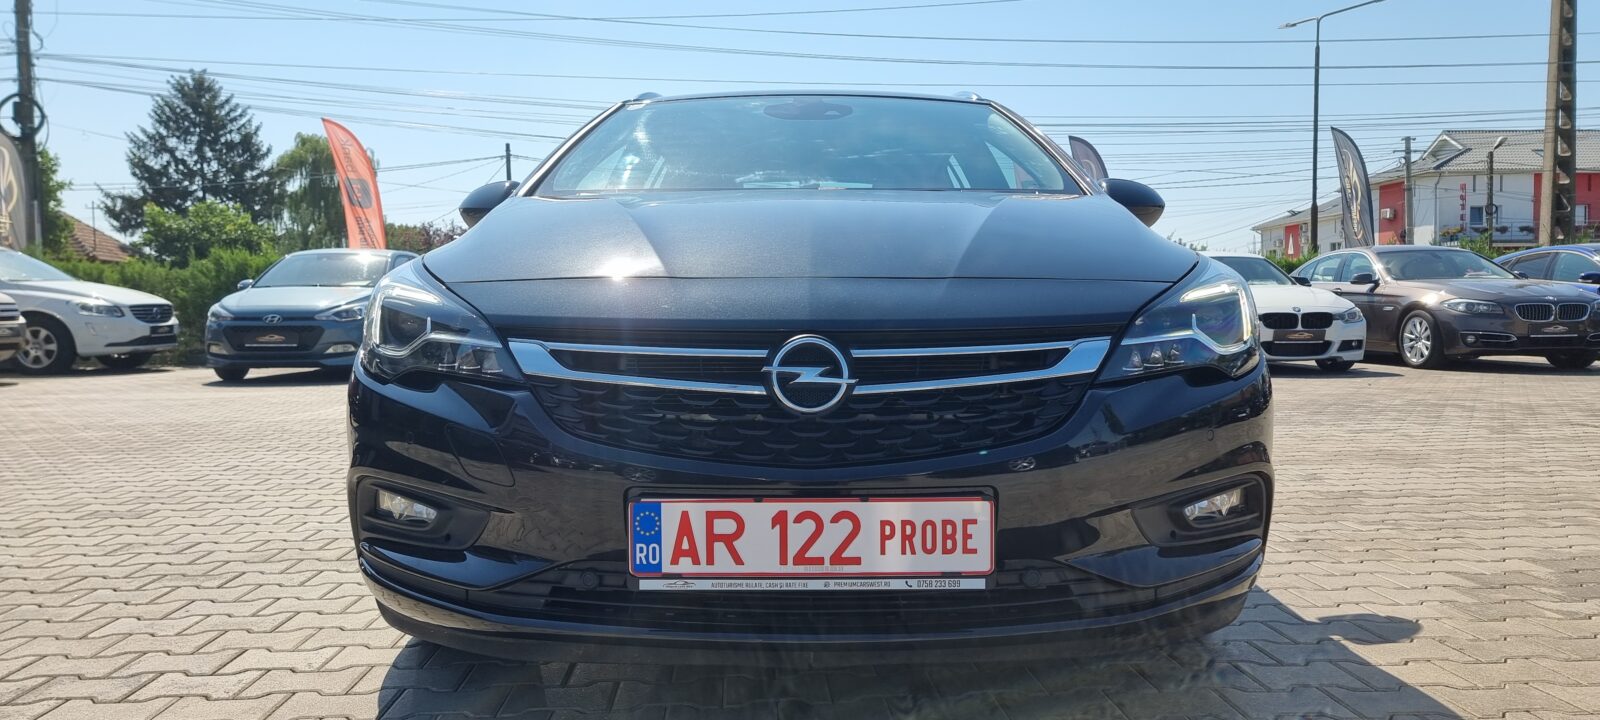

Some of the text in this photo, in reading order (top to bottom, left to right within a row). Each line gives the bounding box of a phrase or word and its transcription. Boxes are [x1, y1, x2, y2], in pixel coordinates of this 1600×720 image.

[670, 510, 978, 565] AR 122 PROBE
[636, 543, 660, 565] RO
[917, 579, 961, 588] 0758 233 699
